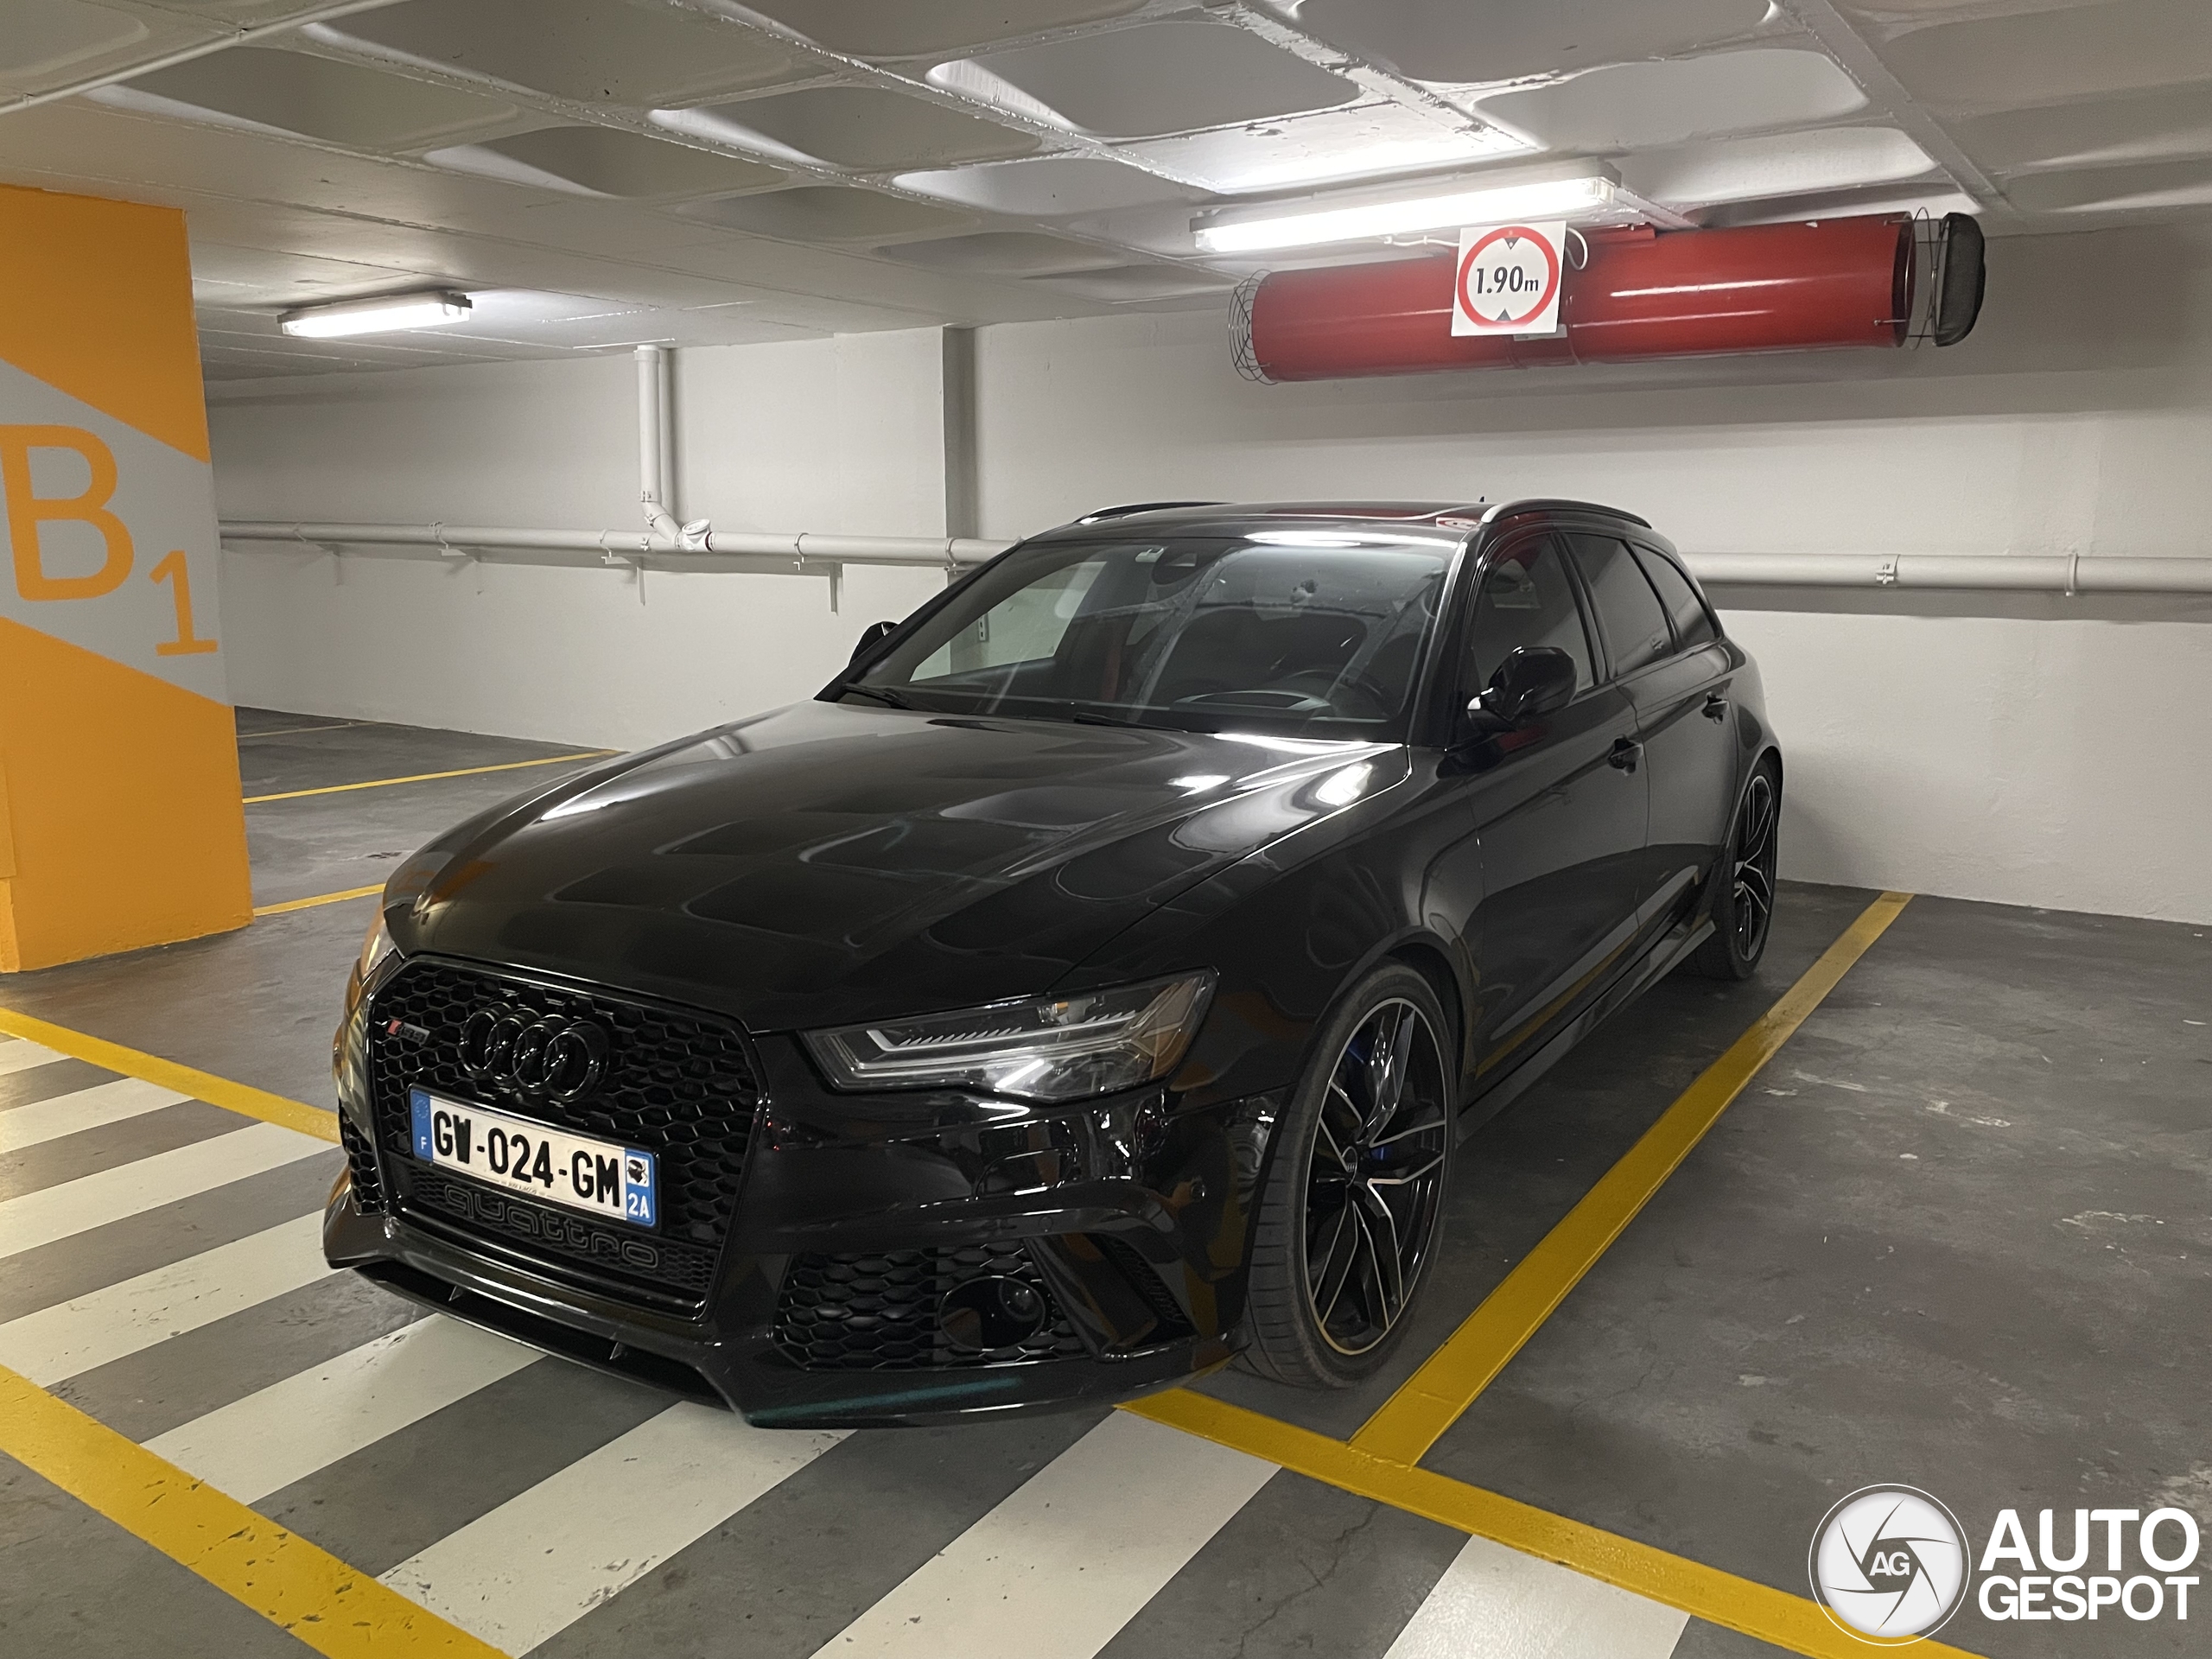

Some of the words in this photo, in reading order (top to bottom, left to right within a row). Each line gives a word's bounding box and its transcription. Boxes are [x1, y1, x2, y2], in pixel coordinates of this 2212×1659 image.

[421, 1136, 428, 1150] F
[433, 1110, 620, 1207] GW-024-GM
[444, 1185, 658, 1268] quattro
[628, 1192, 650, 1219] 2A
